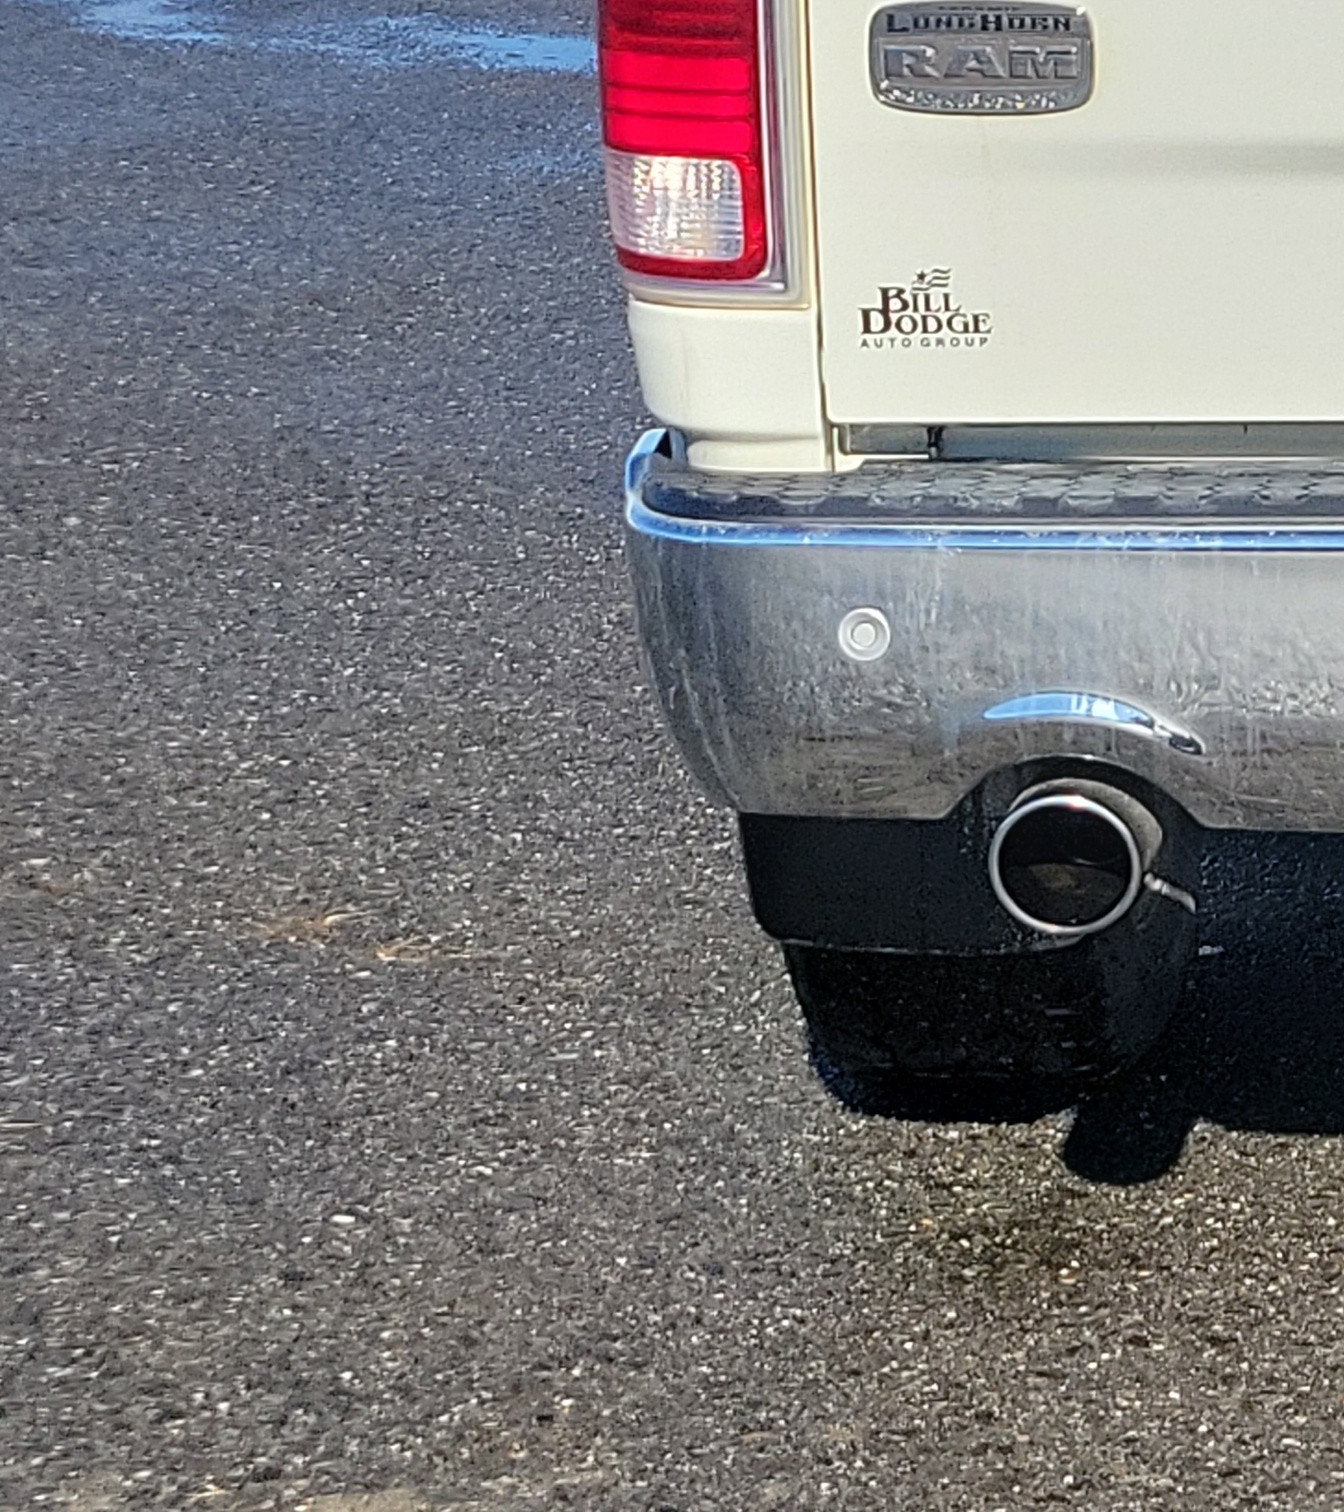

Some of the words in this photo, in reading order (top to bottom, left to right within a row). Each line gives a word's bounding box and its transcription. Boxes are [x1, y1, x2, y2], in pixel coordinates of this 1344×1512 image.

[884, 44, 1078, 80] RAM
[877, 286, 962, 313] BILL
[858, 308, 993, 335] DODGE
[860, 338, 912, 348] AUTO
[920, 338, 988, 348] GROUP
